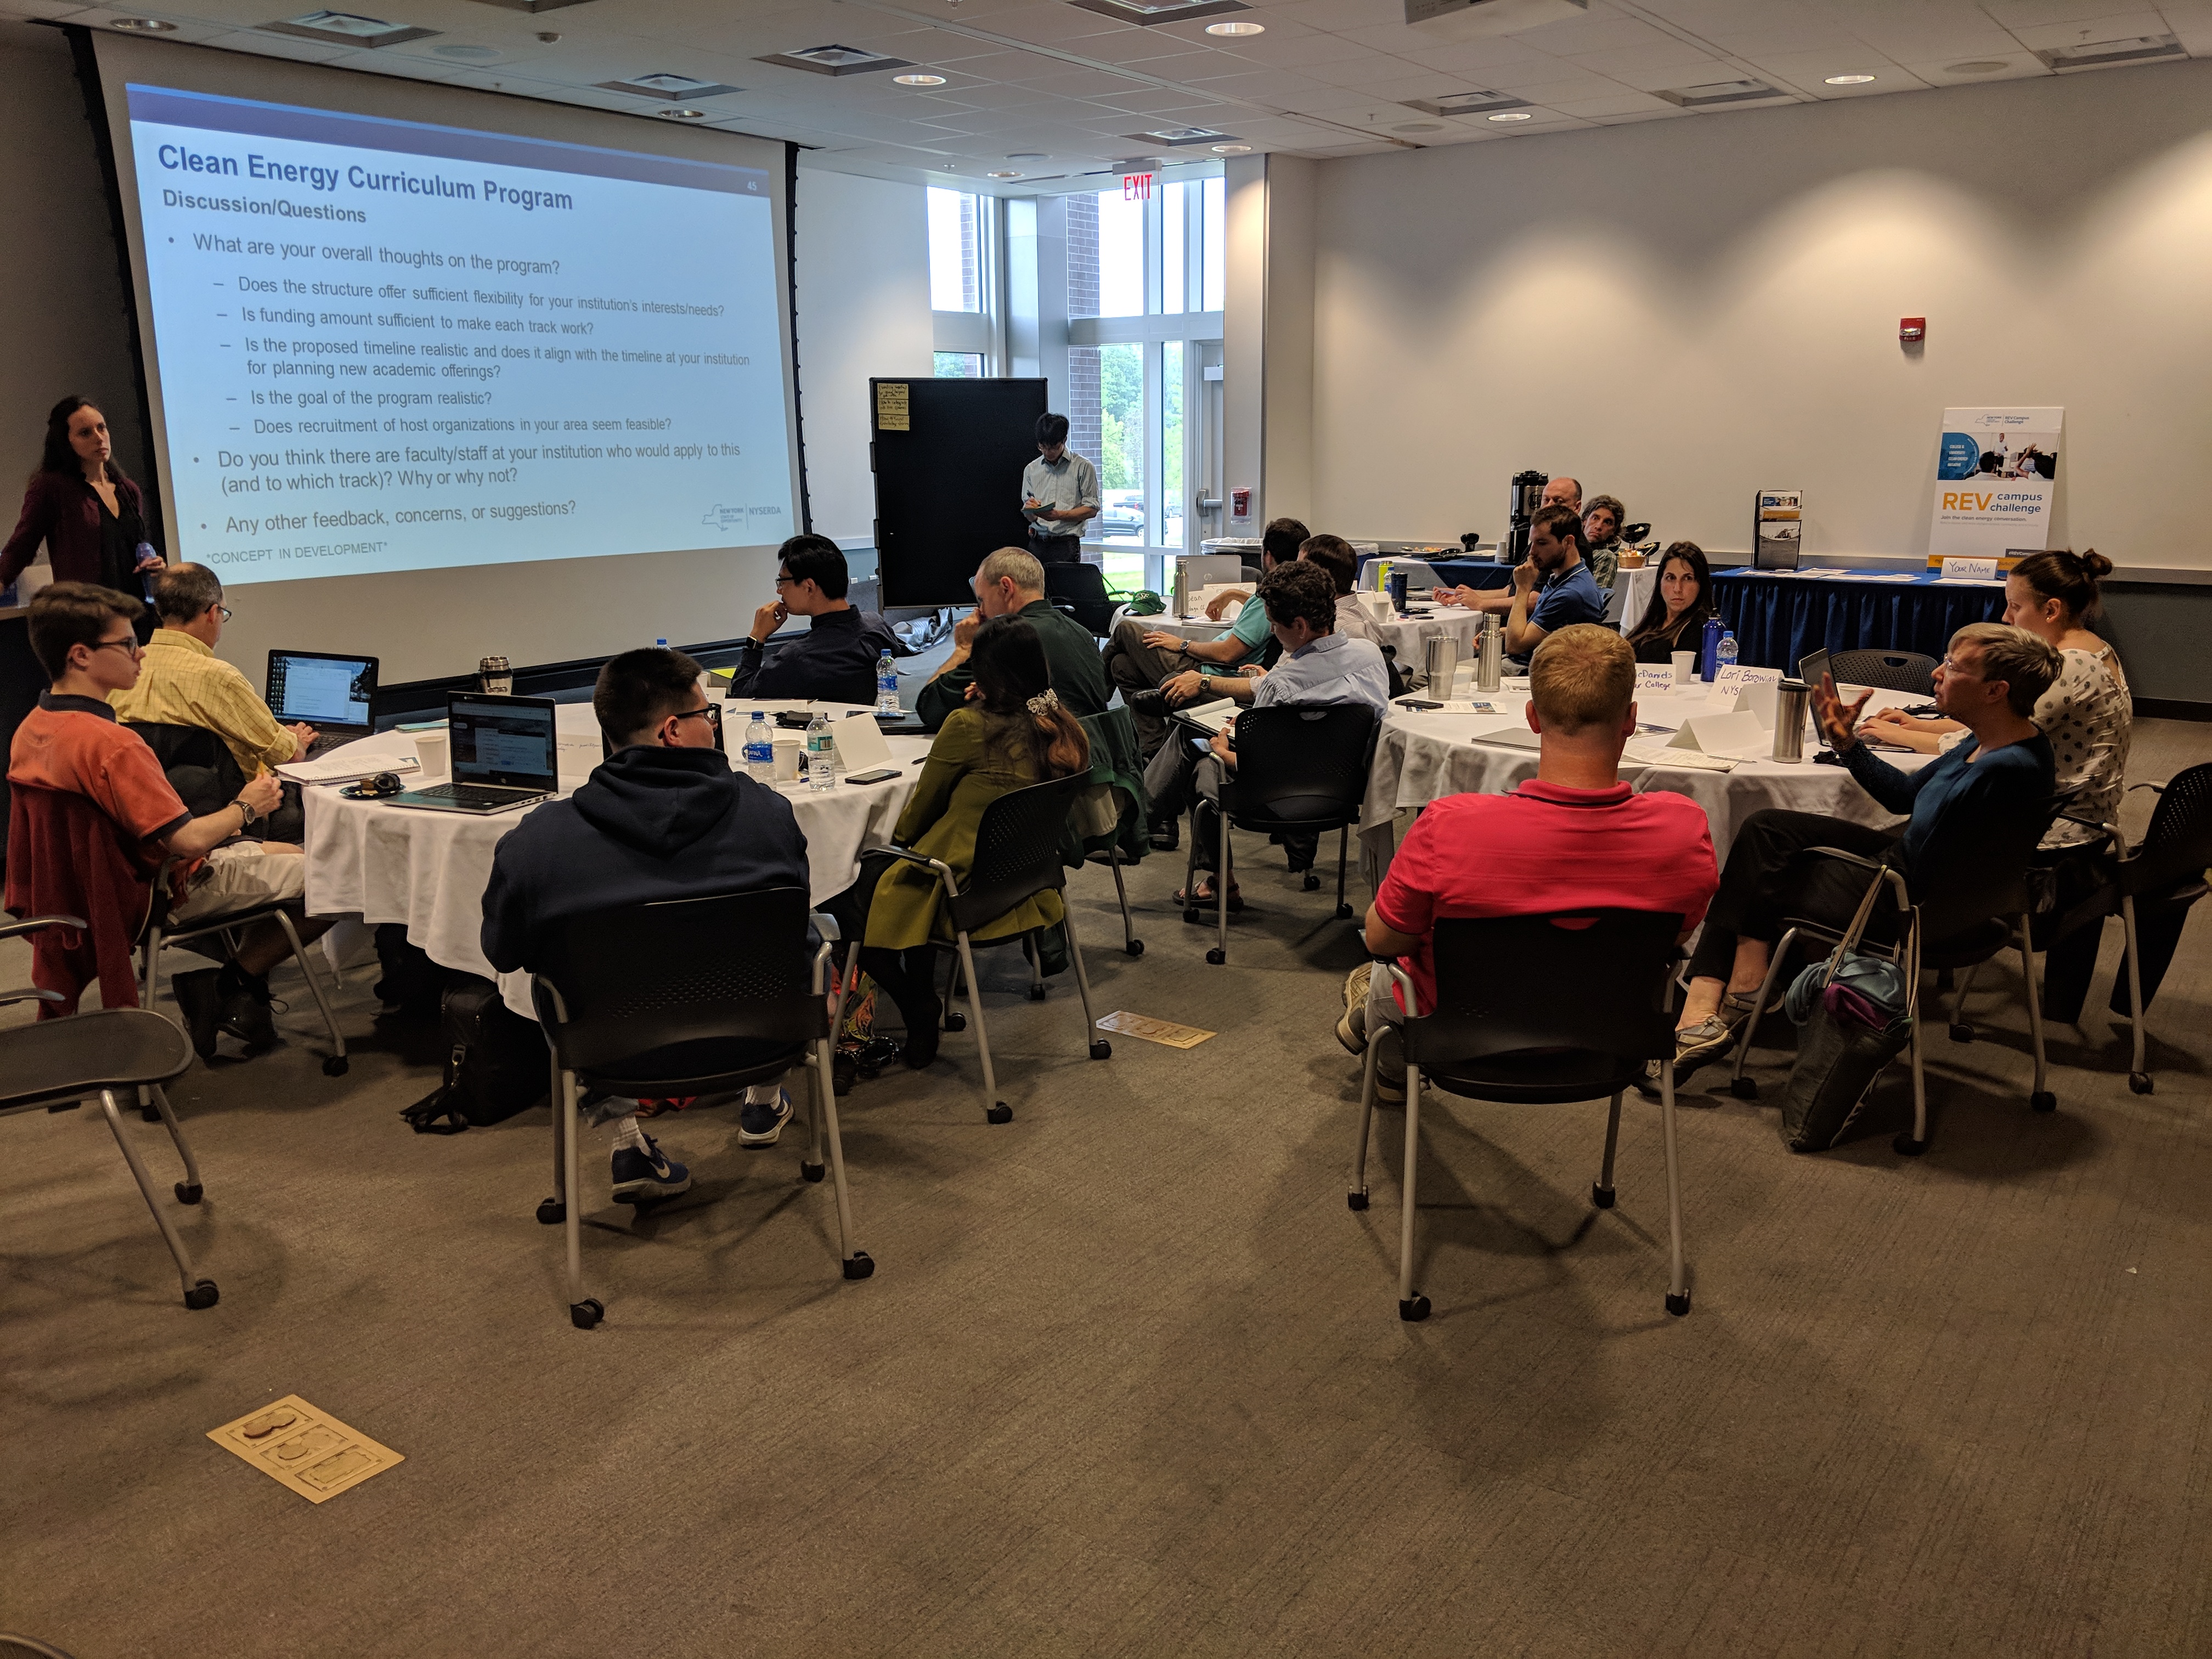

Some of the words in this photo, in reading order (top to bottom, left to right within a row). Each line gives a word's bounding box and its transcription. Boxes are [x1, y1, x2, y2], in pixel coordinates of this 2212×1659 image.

[159, 145, 238, 176] Clean
[248, 154, 338, 191] Energy
[348, 166, 475, 199] Curriculum
[484, 180, 572, 211] Program
[748, 180, 757, 191] 45
[1124, 174, 1152, 201] EXIT
[163, 189, 366, 223] Discussion/Questions
[193, 233, 242, 253] What
[247, 241, 274, 255] are
[280, 244, 315, 260] your
[322, 246, 372, 261] overall
[379, 247, 443, 269] thoughts
[448, 256, 465, 268] on
[471, 254, 493, 269] the
[497, 259, 560, 276] program?
[239, 276, 278, 292] Does
[283, 279, 306, 294] the
[312, 281, 373, 297] structure
[379, 285, 407, 298] offer
[413, 287, 469, 302] sufficient
[473, 290, 523, 308] flexibility
[529, 293, 544, 306] for
[549, 297, 573, 311] your
[578, 297, 638, 312] institution's
[642, 301, 724, 317] interests/needs?
[242, 307, 256, 321] Is
[259, 307, 315, 328] funding
[320, 313, 373, 325] amount
[377, 313, 435, 328] sufficient
[441, 315, 453, 329] to
[458, 317, 491, 330] make
[495, 319, 524, 331] each
[528, 320, 557, 333] track
[561, 322, 594, 335] work?
[246, 337, 258, 352] Is
[263, 338, 287, 352] the
[292, 340, 358, 357] proposed
[364, 341, 415, 355] timeline
[421, 343, 468, 357] realistic
[474, 345, 496, 357] and
[501, 345, 530, 358] does
[534, 347, 541, 359] it
[545, 347, 571, 363] align
[574, 348, 597, 360] with
[601, 349, 618, 362] the
[622, 350, 662, 363] timeline
[666, 352, 675, 363] at
[679, 354, 701, 366] your
[704, 352, 749, 365] institution
[247, 360, 267, 374] for
[273, 360, 335, 379] planning
[340, 365, 367, 375] new
[373, 363, 436, 376] academic
[442, 364, 500, 381] offerings?
[251, 390, 264, 404] Is
[269, 390, 292, 404] the
[298, 391, 328, 408] goal
[333, 391, 345, 404] of
[351, 391, 372, 404] the
[377, 394, 432, 408] program
[438, 391, 492, 404] realistic?
[255, 419, 292, 433] Does
[298, 419, 378, 432] recruitment
[383, 418, 396, 432] of
[400, 418, 428, 431] host
[433, 418, 515, 435] organizations
[520, 418, 531, 430] in
[534, 421, 559, 434] your
[563, 421, 588, 430] area
[592, 421, 622, 430] seem
[625, 418, 671, 430] feasible?
[218, 451, 243, 467] Do
[249, 454, 279, 471] you
[285, 449, 325, 465] think
[330, 448, 370, 464] there
[376, 451, 399, 462] are
[405, 445, 488, 465] faculty/staff
[492, 446, 505, 460] at
[509, 448, 538, 463] your
[542, 444, 602, 459] institution
[606, 444, 632, 458] who
[635, 443, 669, 457] would
[674, 443, 703, 460] apply
[707, 444, 718, 456] to
[721, 443, 740, 456] this
[266, 476, 282, 491] to
[286, 473, 334, 489] which
[339, 471, 392, 490] track)?
[398, 470, 433, 488] Why
[437, 473, 451, 484] or
[455, 469, 483, 487] why
[488, 467, 517, 482] not?
[1942, 492, 1994, 511] REV
[1997, 493, 2042, 503] campus
[226, 517, 259, 535] Any
[265, 514, 307, 531] other
[313, 509, 389, 527] feedback,
[396, 509, 466, 523] concerns,
[472, 507, 486, 519] or
[490, 500, 575, 521] suggestions?
[749, 506, 781, 515] NYSERDA
[1990, 503, 2041, 514] challenge
[279, 548, 291, 559] IN
[1638, 669, 1672, 679] cDaniels
[1720, 669, 1741, 681] Lori
[1645, 680, 1670, 691] College
[1721, 685, 1742, 696] NYS
